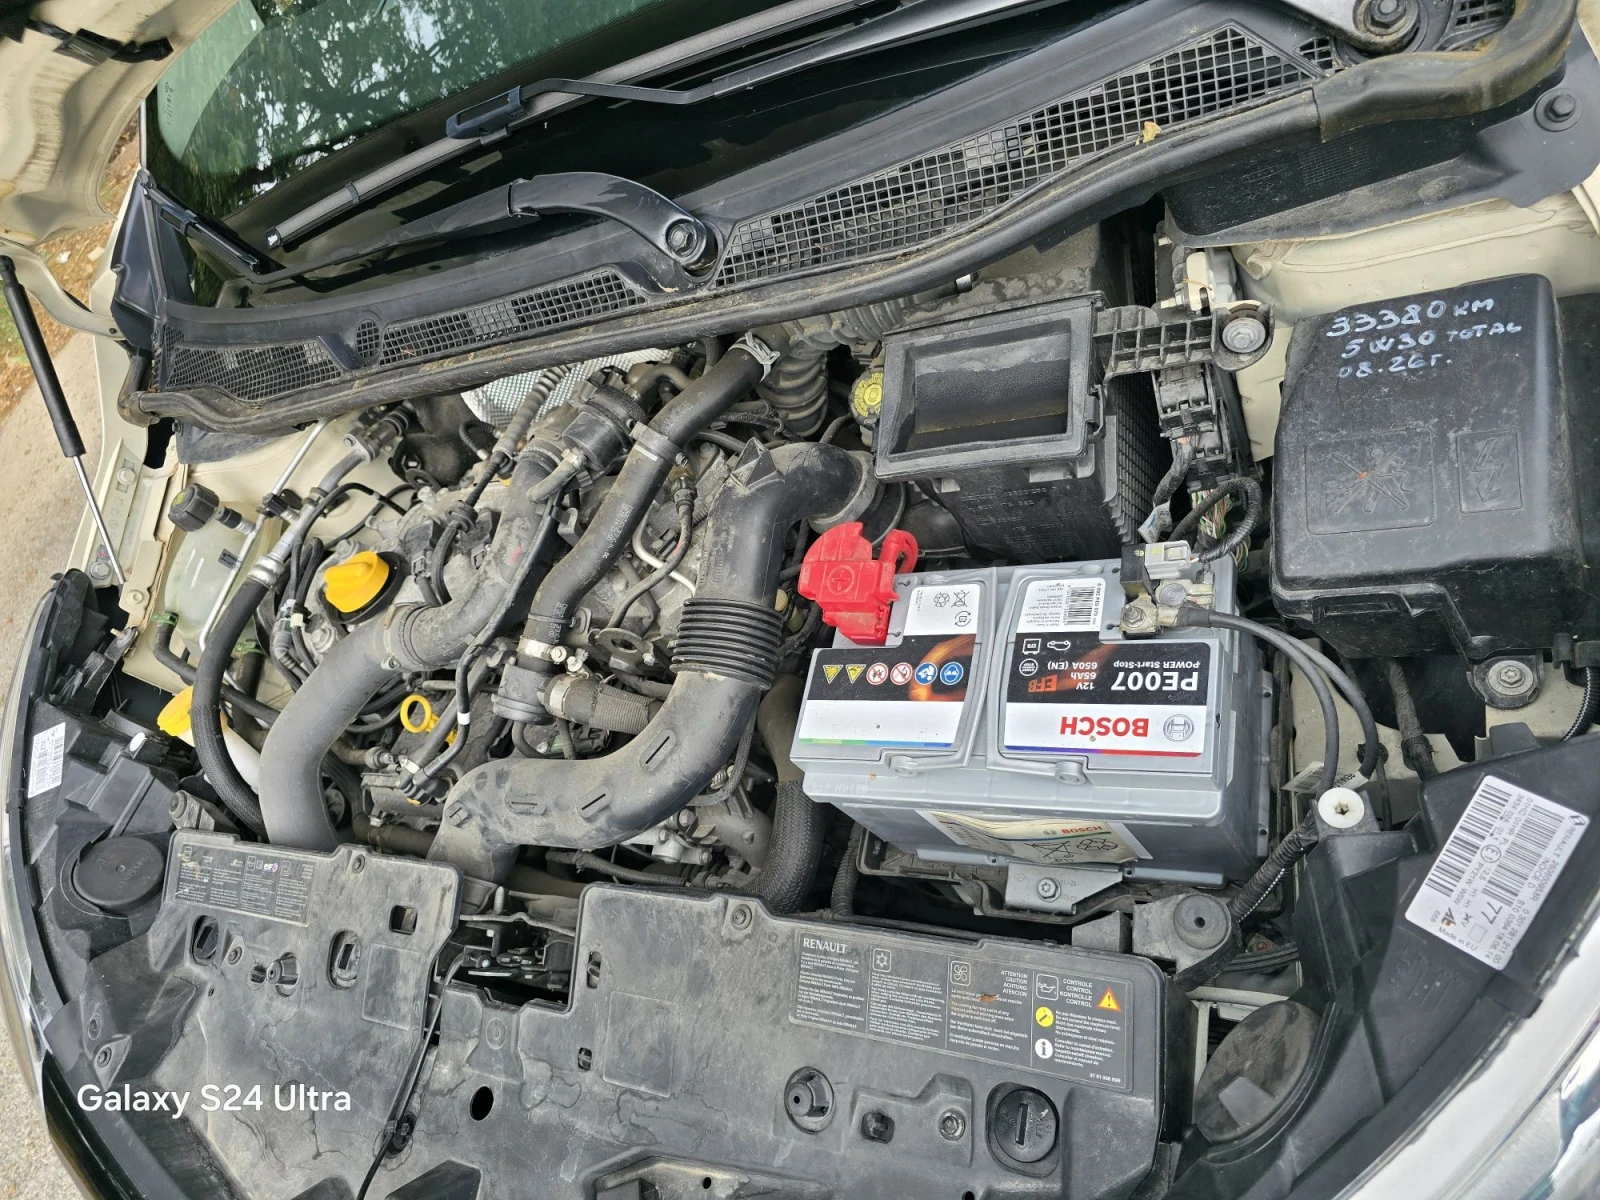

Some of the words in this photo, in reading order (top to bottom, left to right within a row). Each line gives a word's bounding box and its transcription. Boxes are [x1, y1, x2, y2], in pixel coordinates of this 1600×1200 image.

[1326, 300, 1446, 337] 33380
[1341, 330, 1436, 359] 5W30
[1446, 322, 1522, 342] TOTAL
[1047, 659, 1068, 669] (EN)
[1071, 661, 1097, 669] 650A
[1113, 659, 1160, 669] Start-Stop
[1163, 660, 1198, 669] POWER
[1070, 670, 1096, 679] 65Ah
[1027, 673, 1056, 693] EFB
[1075, 681, 1094, 689] 12V
[1110, 669, 1198, 692] PE007
[1059, 715, 1148, 736] BOSCH
[1061, 825, 1103, 836] BOSCH
[1552, 825, 1575, 857] RENAULT
[1464, 860, 1482, 886] PY21W
[1530, 856, 1549, 881] INDICE
[1526, 881, 1534, 889] D
[1452, 887, 1466, 905] W5W
[1478, 899, 1502, 924] 77
[1513, 913, 1525, 927] 301
[1437, 926, 1458, 941] Made
[1458, 938, 1468, 946] in
[1467, 942, 1477, 951] EU
[803, 937, 847, 954] RENAULT
[1001, 970, 1027, 979] ATTENTION
[1006, 976, 1027, 984] CAUTION
[1003, 982, 1026, 990] ACHTUNG
[1063, 978, 1092, 988] CONTROLE
[1066, 985, 1092, 994] CONTROL
[1059, 990, 1092, 1001] KONTROLLE
[1066, 998, 1092, 1007] CONTROL
